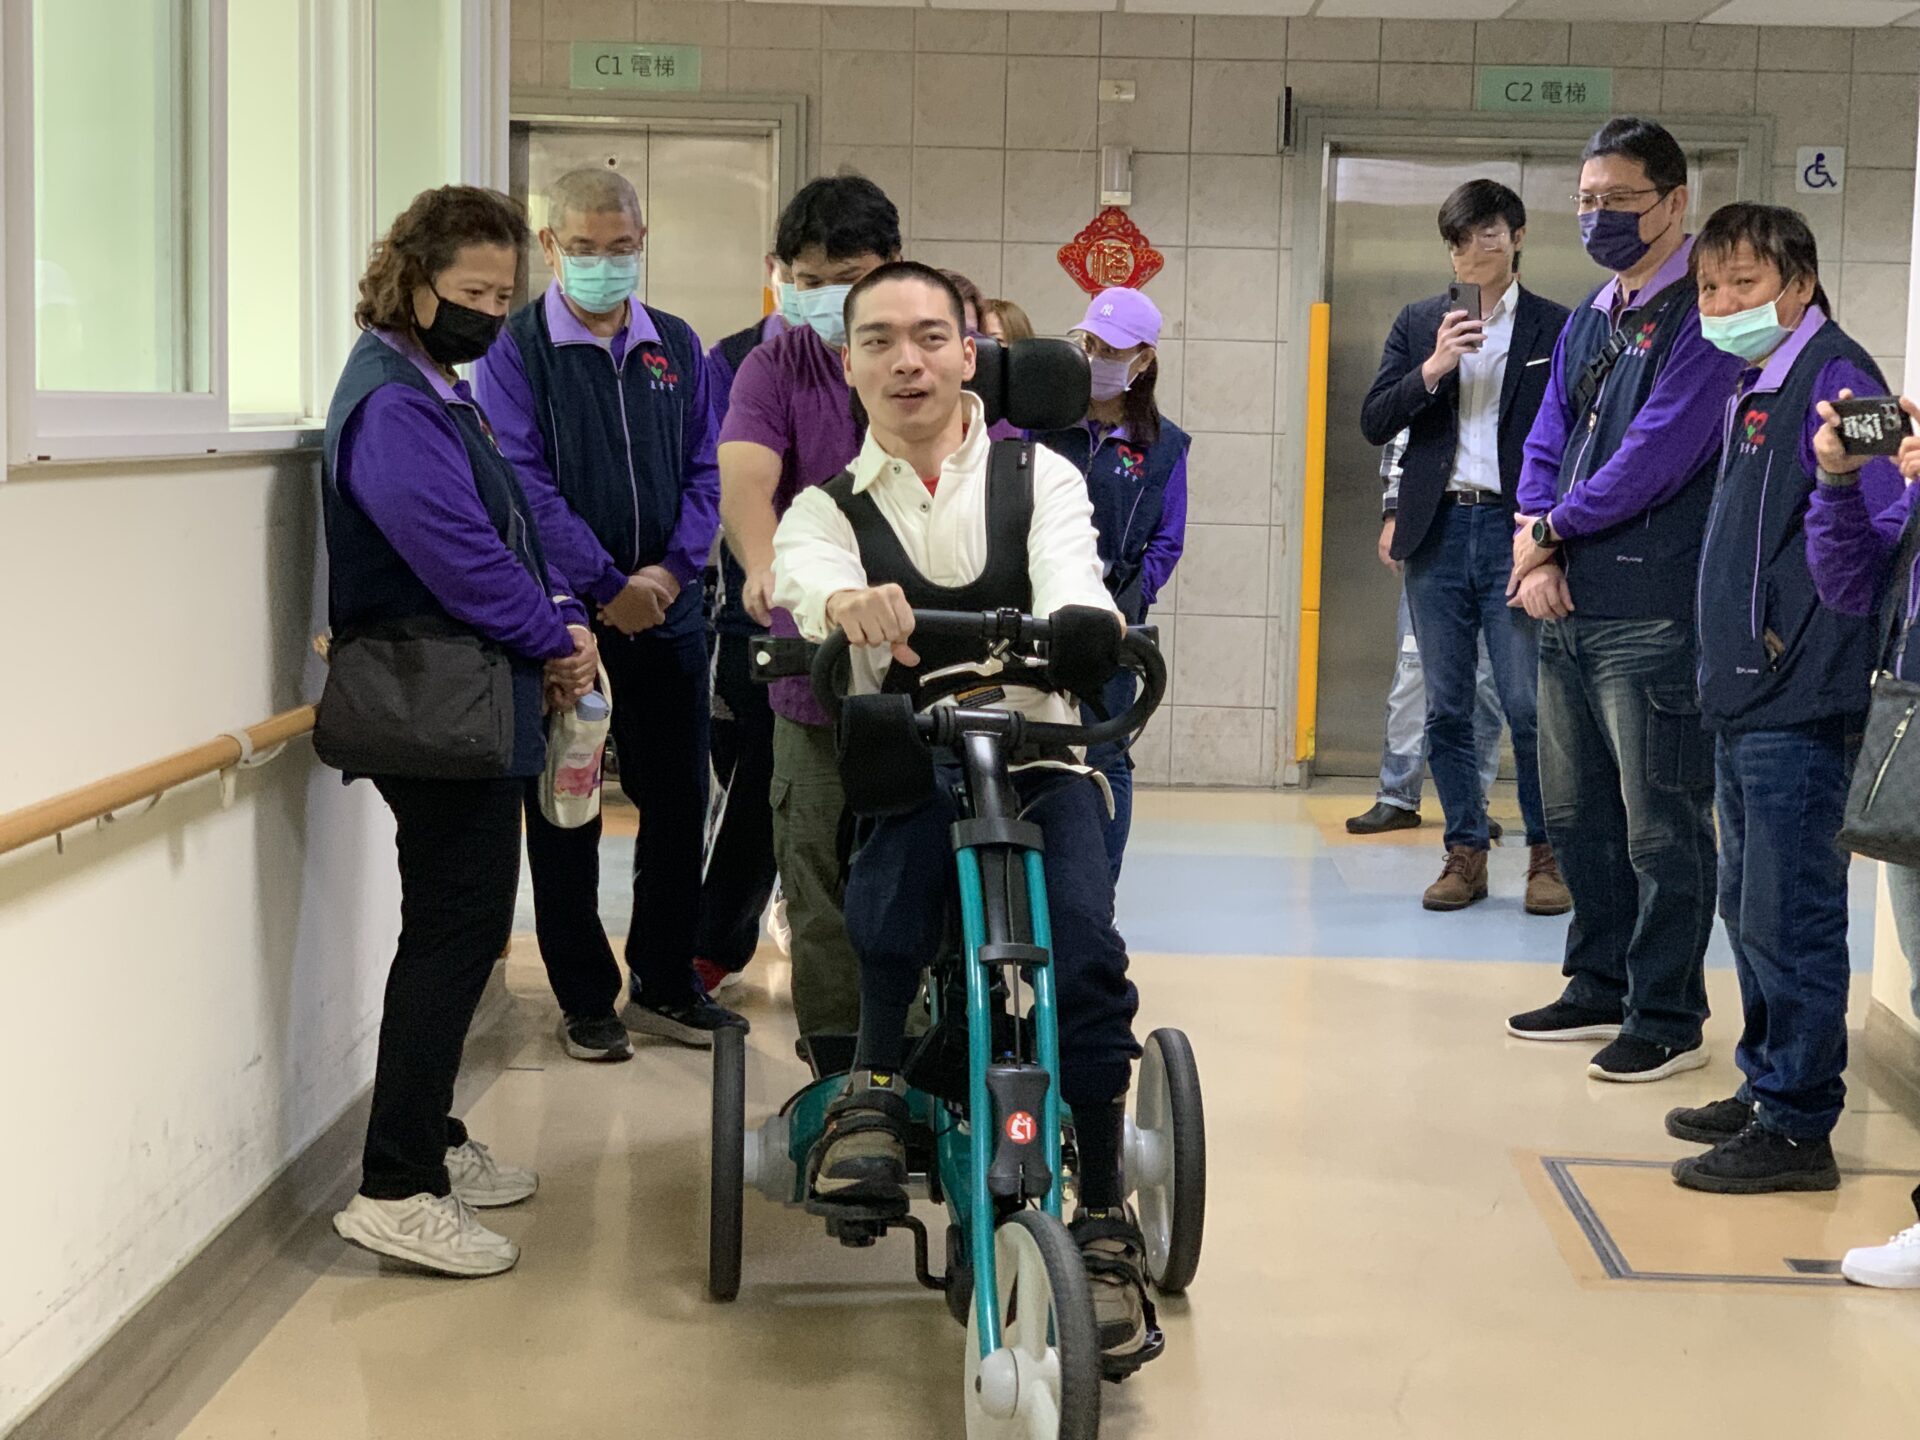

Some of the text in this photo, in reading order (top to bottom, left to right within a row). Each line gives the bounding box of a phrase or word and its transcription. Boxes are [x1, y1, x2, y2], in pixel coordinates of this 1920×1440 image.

[595, 55, 675, 77] C1 電梯
[1505, 82, 1586, 104] C2 電梯
[1090, 240, 1131, 285] 福
